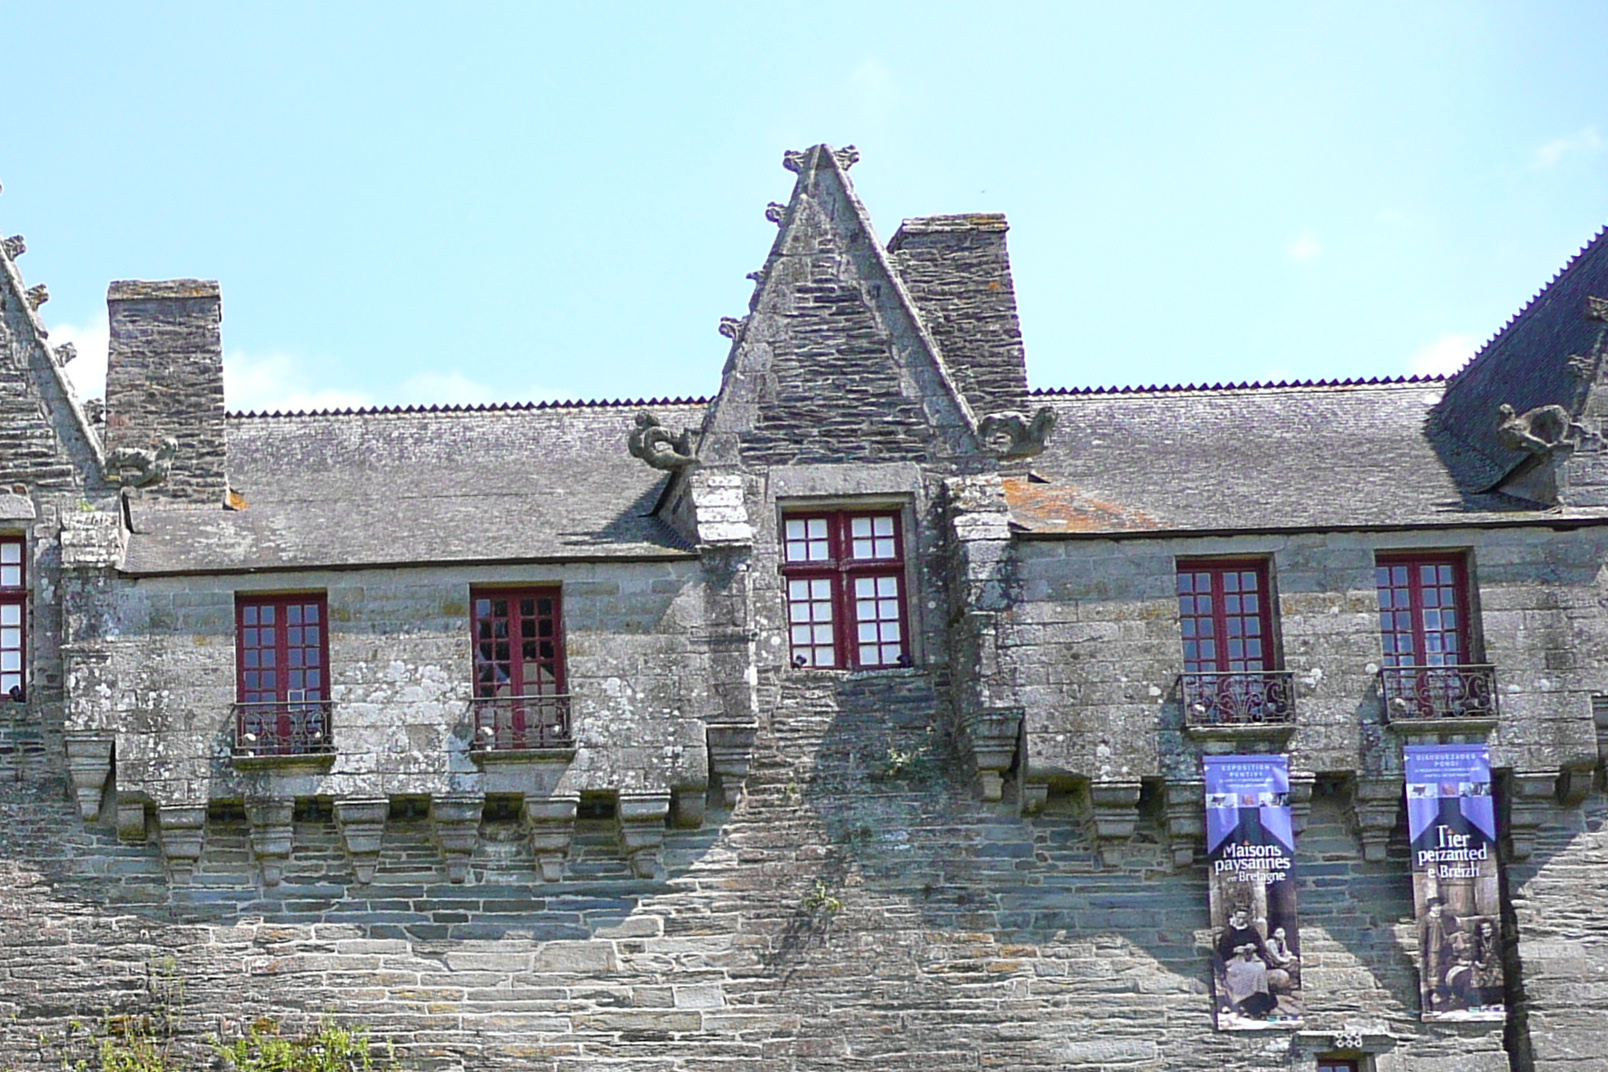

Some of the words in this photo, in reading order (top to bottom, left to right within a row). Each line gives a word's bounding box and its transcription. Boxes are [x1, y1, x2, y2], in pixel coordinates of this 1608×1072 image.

[1222, 764, 1271, 772] EXPOSITION
[1436, 825, 1471, 848] Tier
[1222, 842, 1282, 858] Maisons
[1418, 842, 1488, 866] peizanted
[1214, 857, 1291, 875] paysannes
[1427, 867, 1436, 878] e
[1440, 862, 1479, 878] Breizh
[1238, 870, 1286, 884] Bretagne
